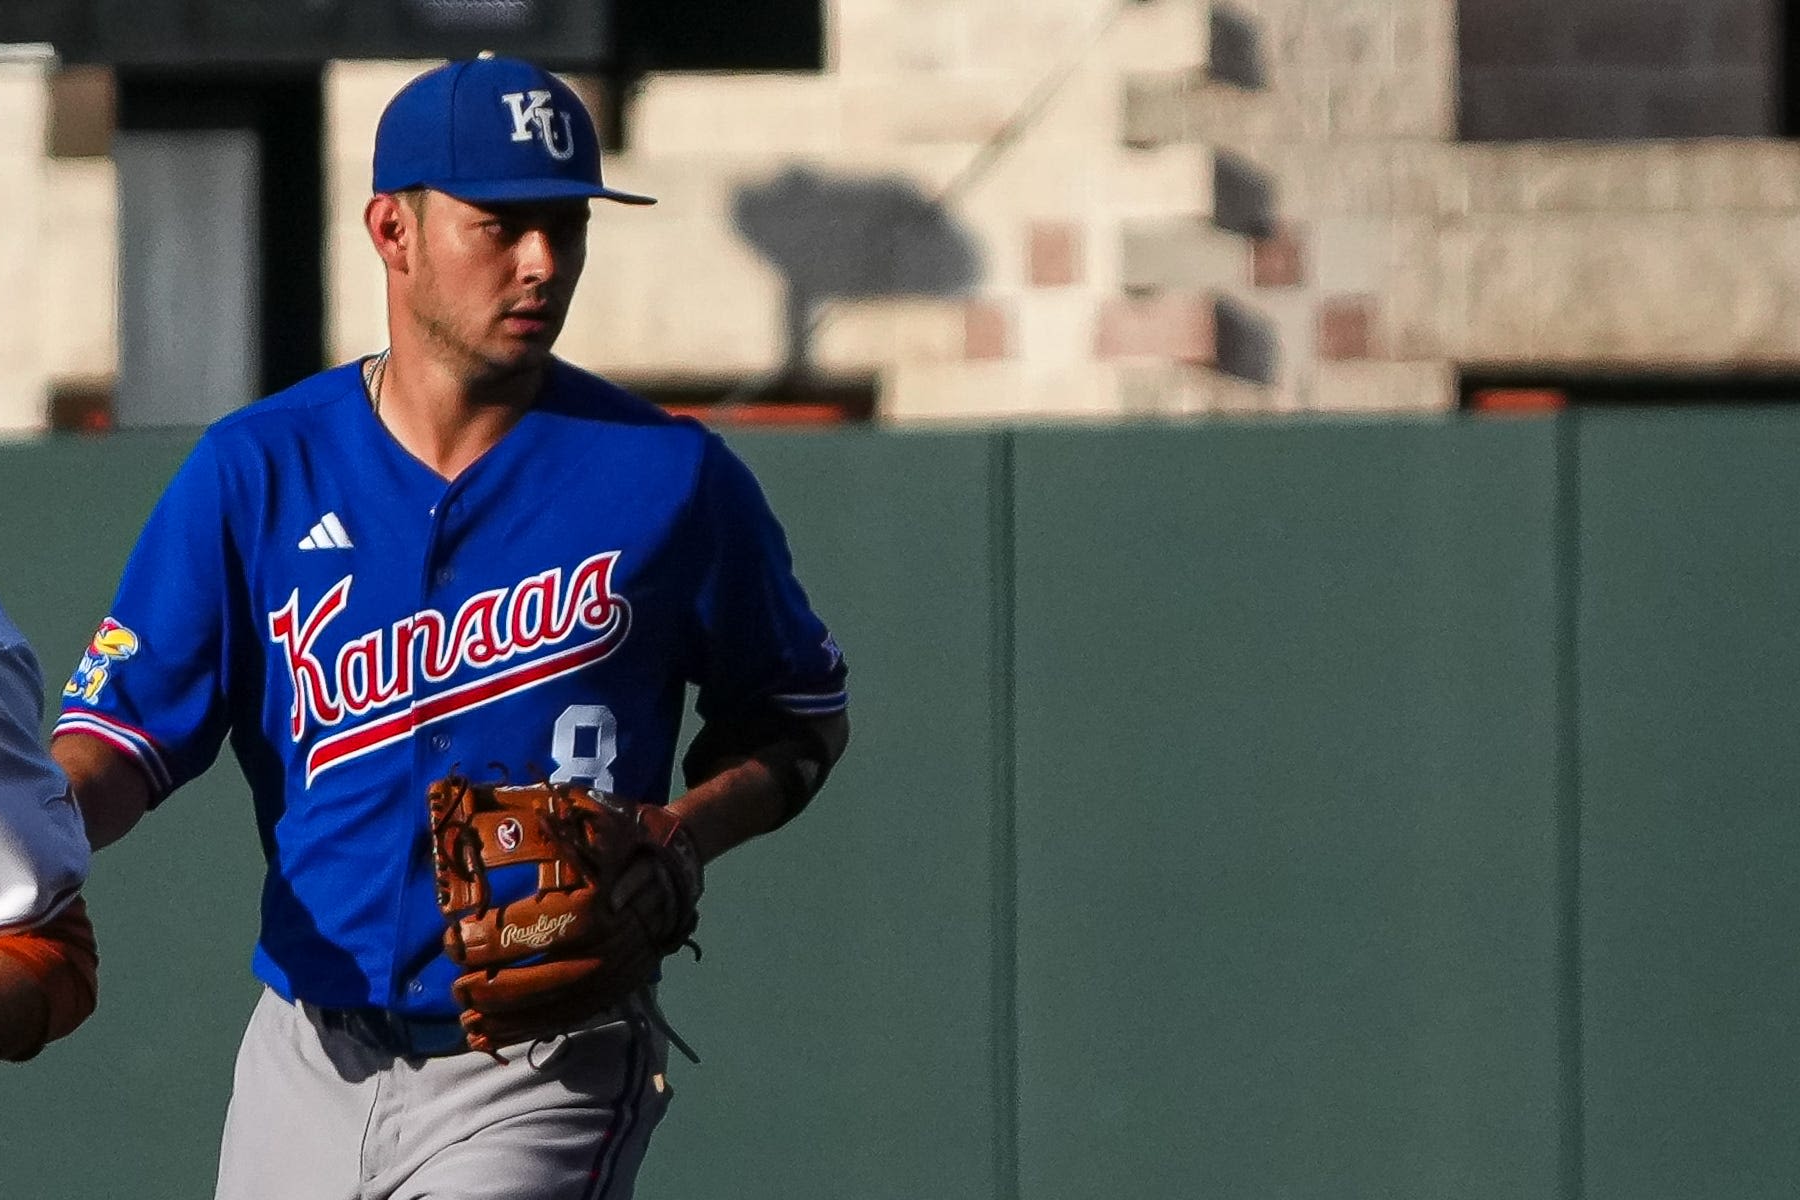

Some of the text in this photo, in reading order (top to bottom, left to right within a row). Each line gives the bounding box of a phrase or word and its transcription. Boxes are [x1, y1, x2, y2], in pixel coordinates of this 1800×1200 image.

[501, 90, 574, 160] KU
[268, 550, 622, 742] Kansas
[549, 704, 617, 793] 8
[500, 911, 577, 948] Rawlings
